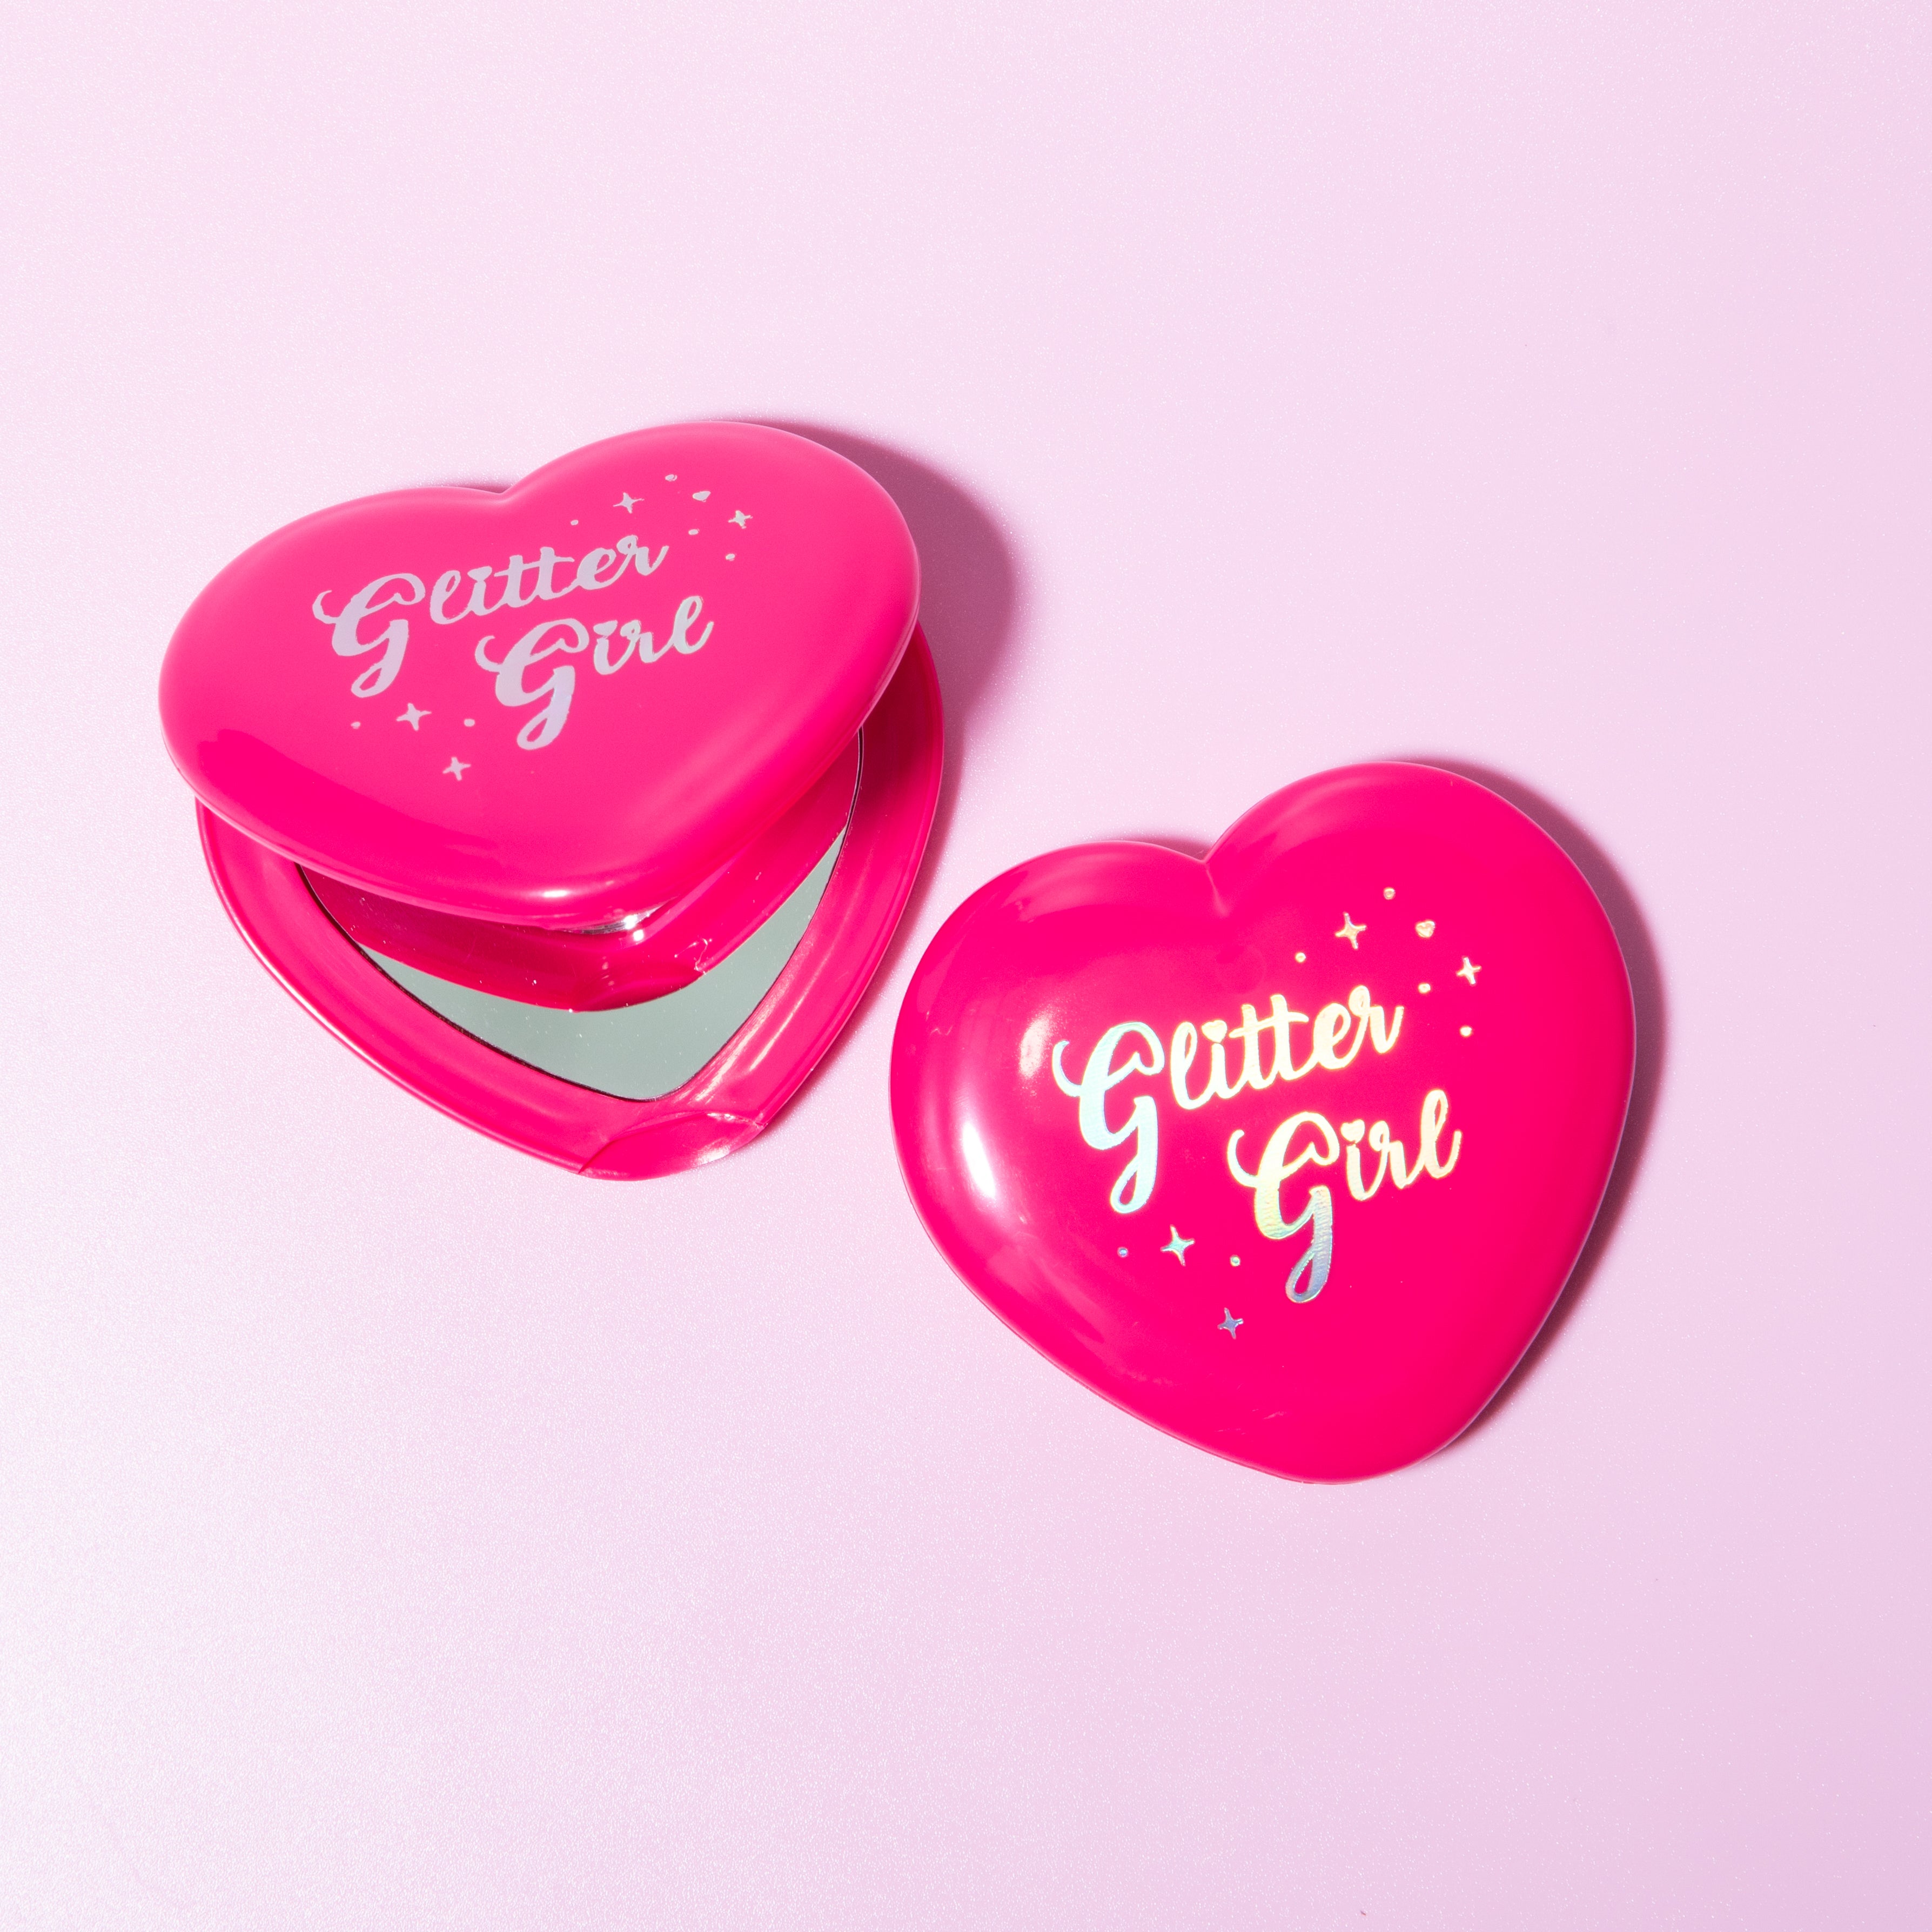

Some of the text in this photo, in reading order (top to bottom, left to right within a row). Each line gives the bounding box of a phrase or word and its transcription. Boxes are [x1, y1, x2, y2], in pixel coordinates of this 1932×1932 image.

[312, 534, 669, 698] Glitter
[474, 595, 714, 750] Girl
[1052, 985, 1405, 1213] Glitter
[1226, 1089, 1463, 1303] Girl
